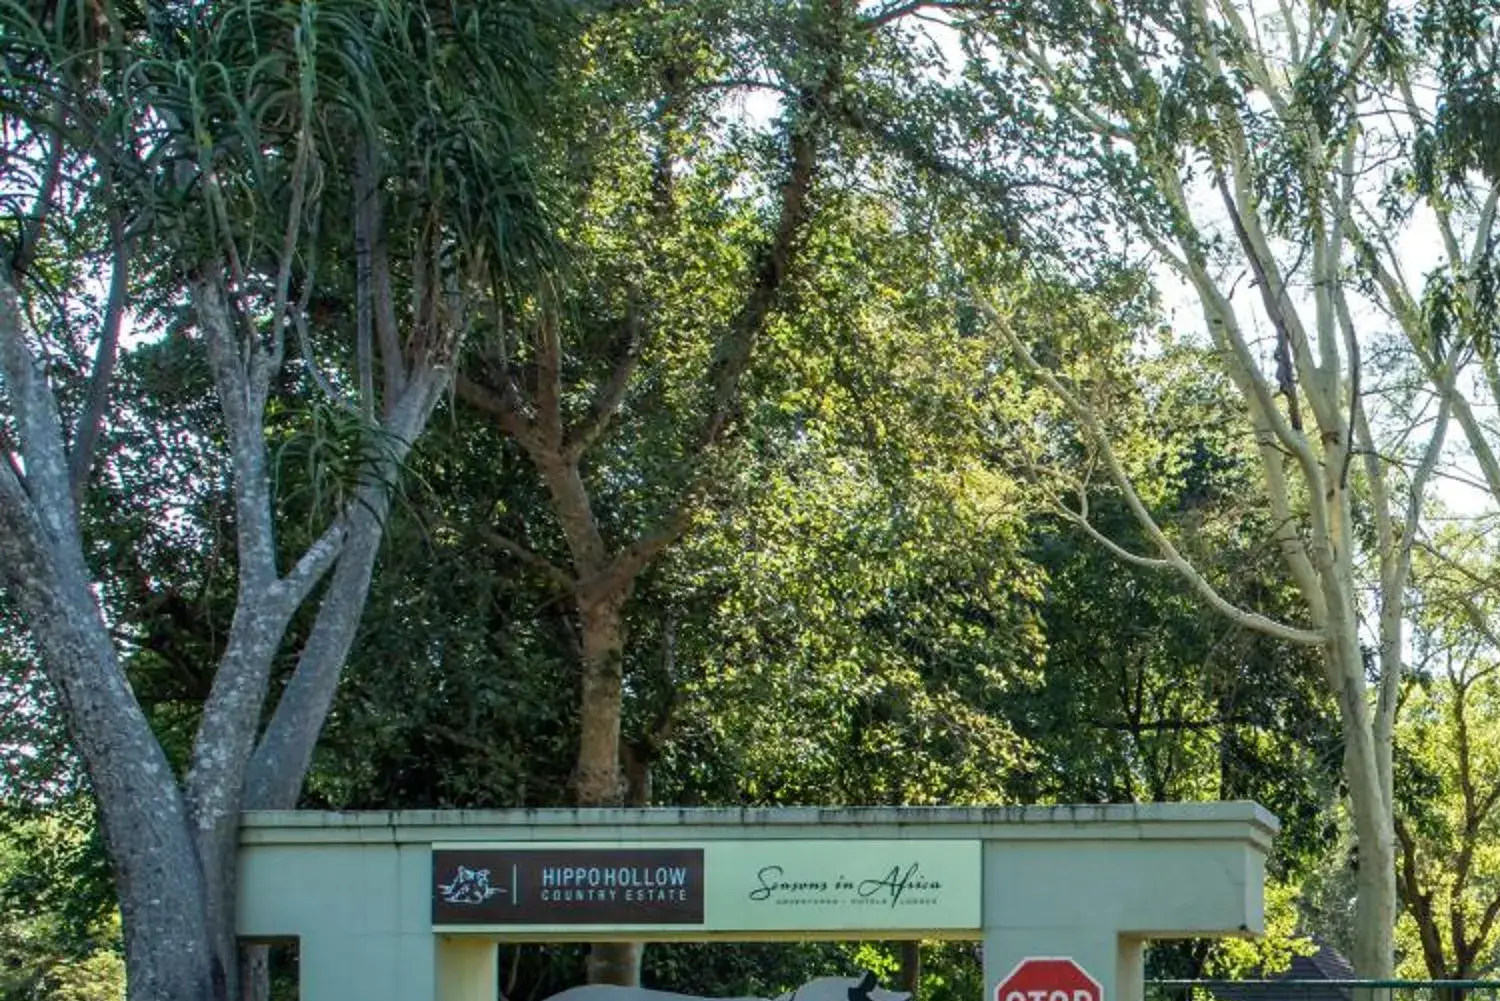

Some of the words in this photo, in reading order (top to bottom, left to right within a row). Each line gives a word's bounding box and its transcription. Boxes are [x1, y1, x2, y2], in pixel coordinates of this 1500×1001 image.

[540, 889, 616, 901] COUNTRY
[625, 889, 687, 901] ESTATE
[749, 865, 828, 901] Seasons
[834, 875, 854, 890] in
[857, 861, 942, 909] Africa
